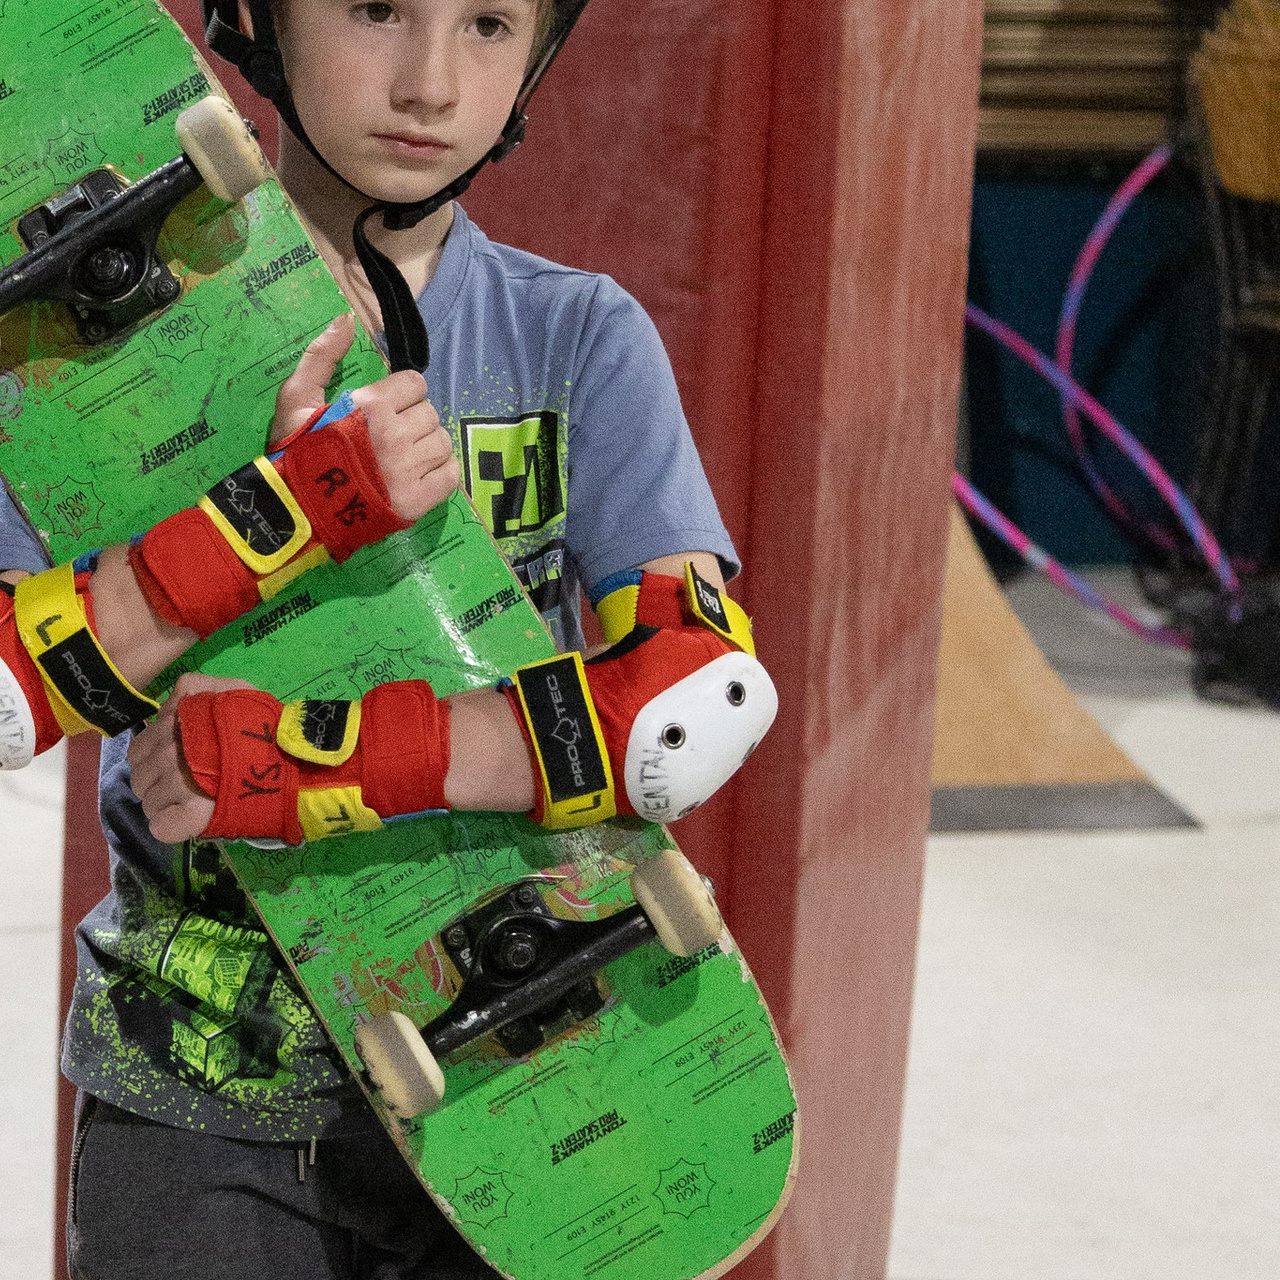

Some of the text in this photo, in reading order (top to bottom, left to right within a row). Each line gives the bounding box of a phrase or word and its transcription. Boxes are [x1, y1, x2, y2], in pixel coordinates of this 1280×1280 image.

[54, 140, 89, 166] WON!
[64, 153, 91, 174] YOU
[166, 325, 193, 346] YOU
[361, 656, 396, 682] WON!
[593, 1116, 627, 1140] TONY
[461, 1179, 495, 1205] WON!
[664, 1170, 698, 1195] WON!
[674, 1182, 700, 1203] YOU
[470, 1191, 498, 1213] YOU
